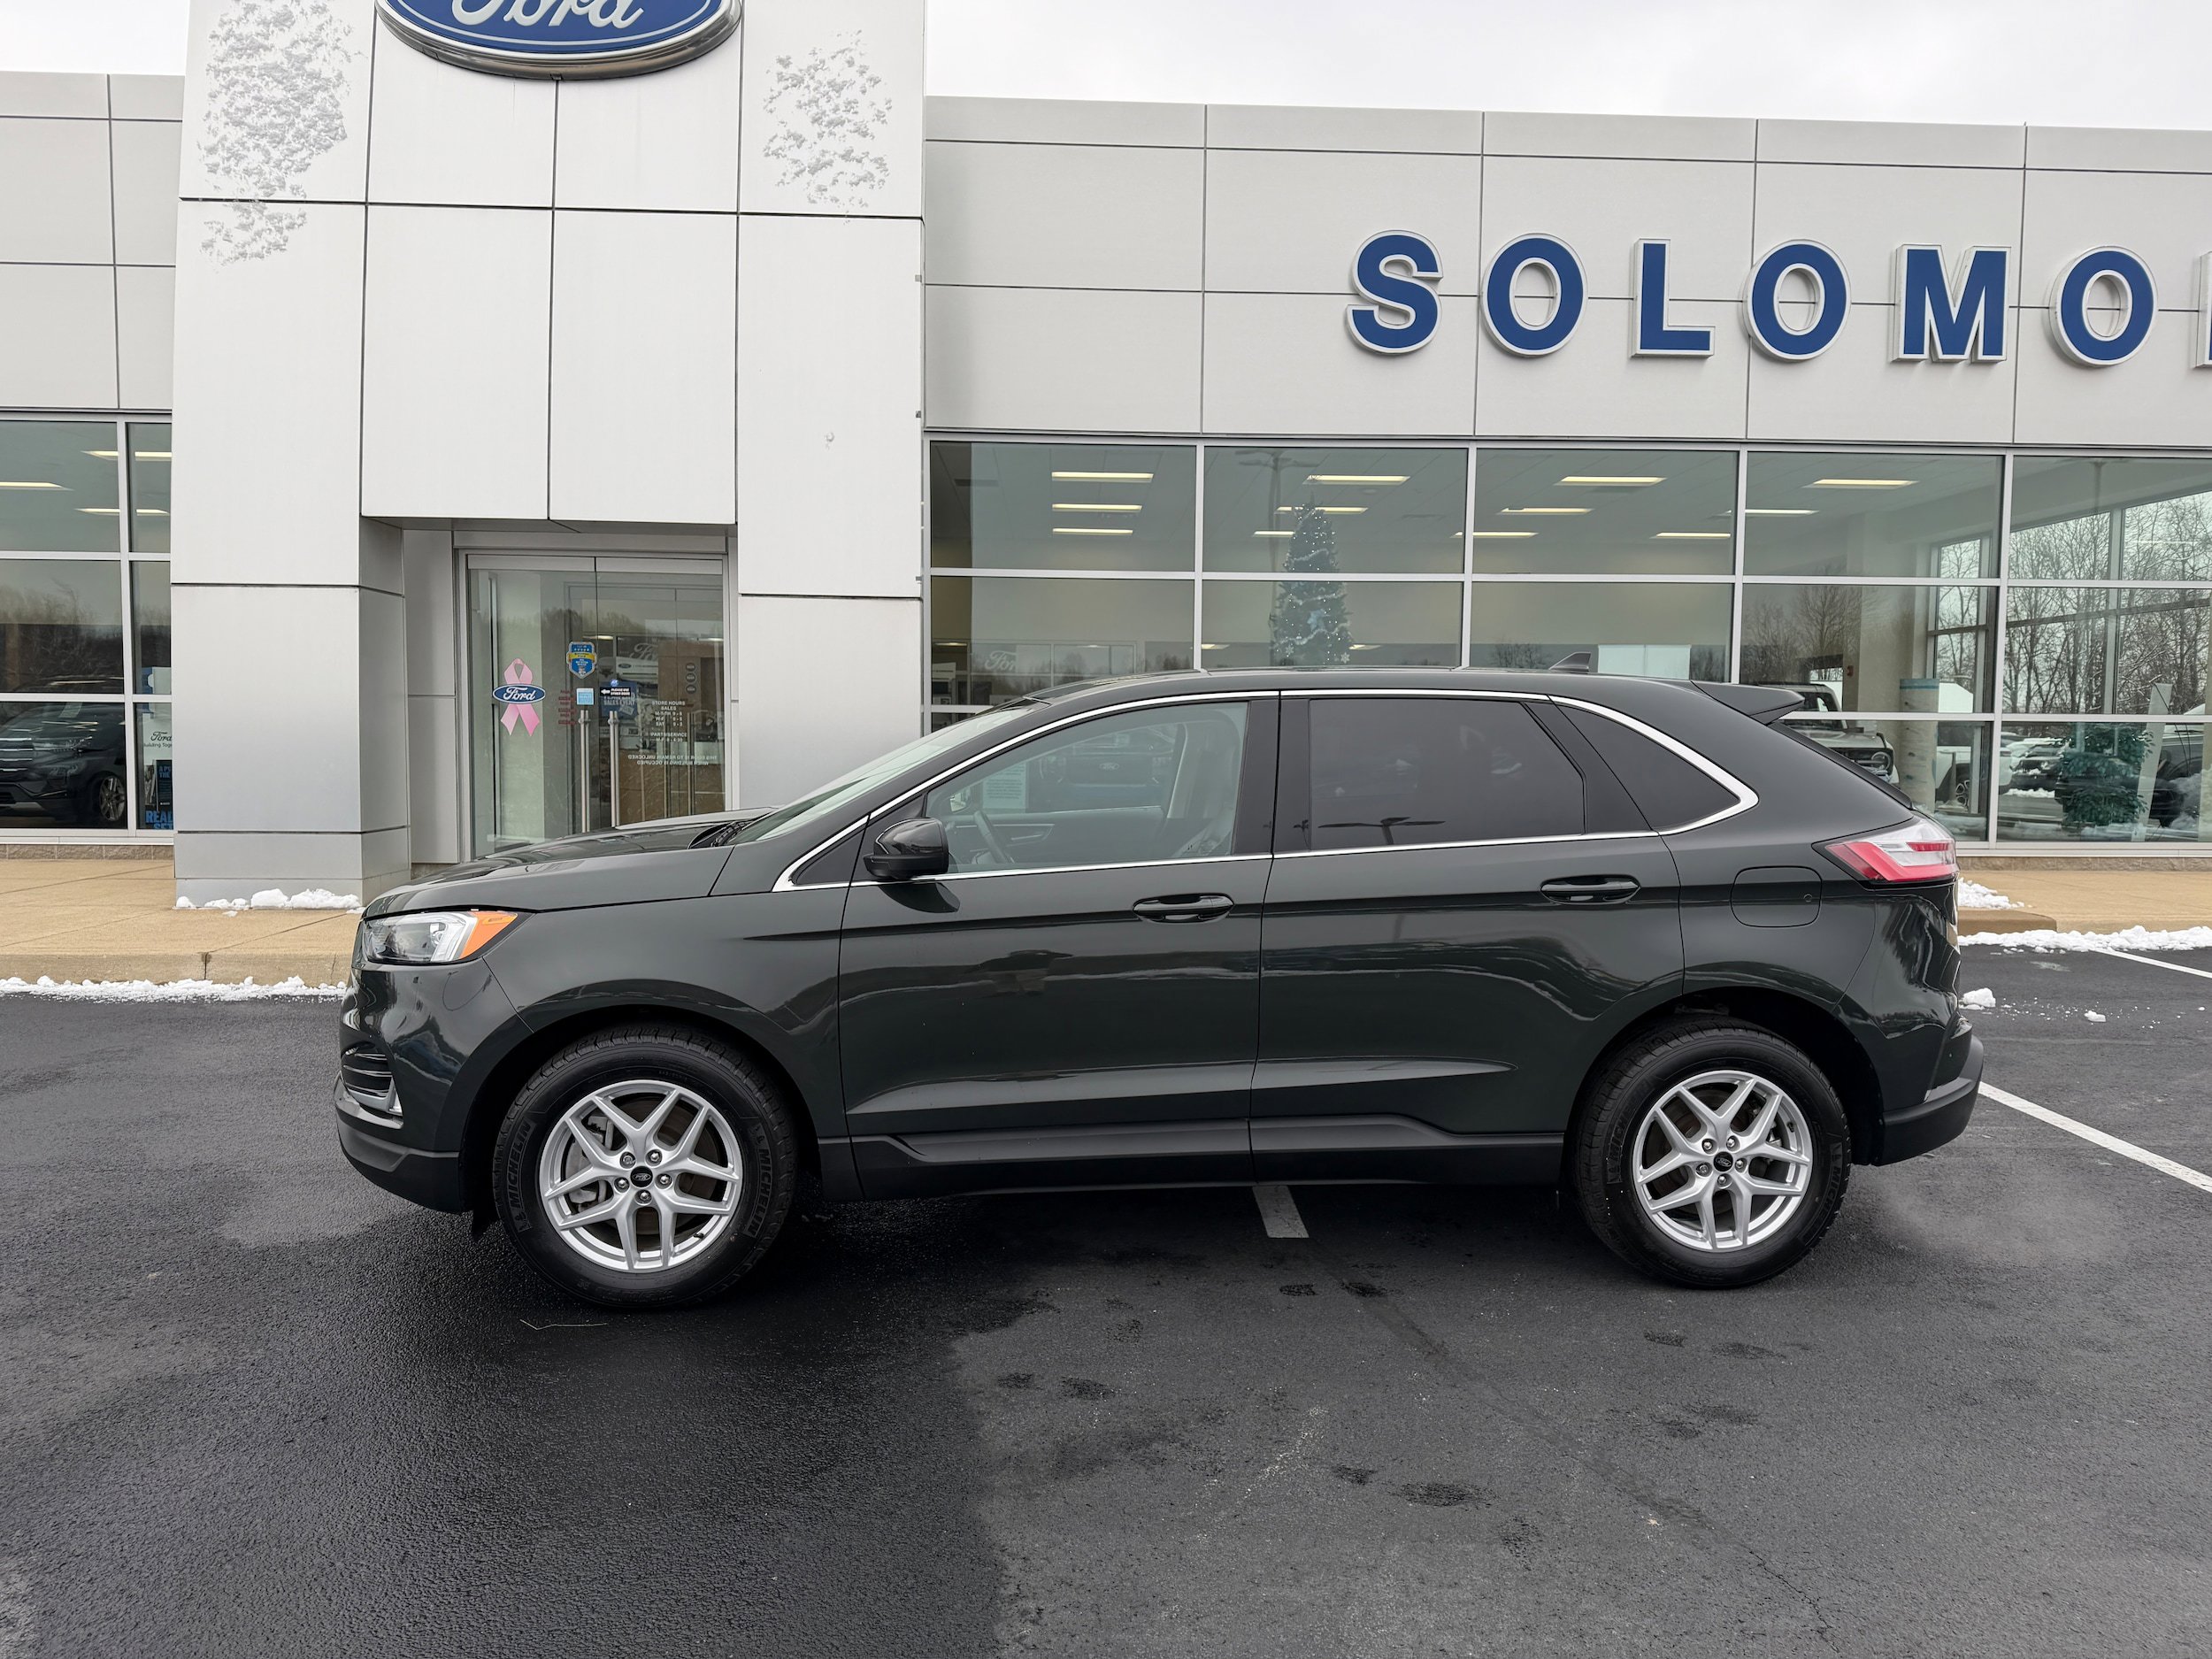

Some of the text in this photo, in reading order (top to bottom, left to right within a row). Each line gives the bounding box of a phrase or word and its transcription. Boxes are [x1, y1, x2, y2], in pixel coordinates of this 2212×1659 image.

[1346, 229, 2212, 367] SOLOMO
[984, 649, 1018, 671] For
[503, 687, 536, 700] Ford
[150, 731, 173, 741] Ford
[507, 1119, 532, 1210] MICHELIN
[747, 1148, 772, 1236] MICHELIN
